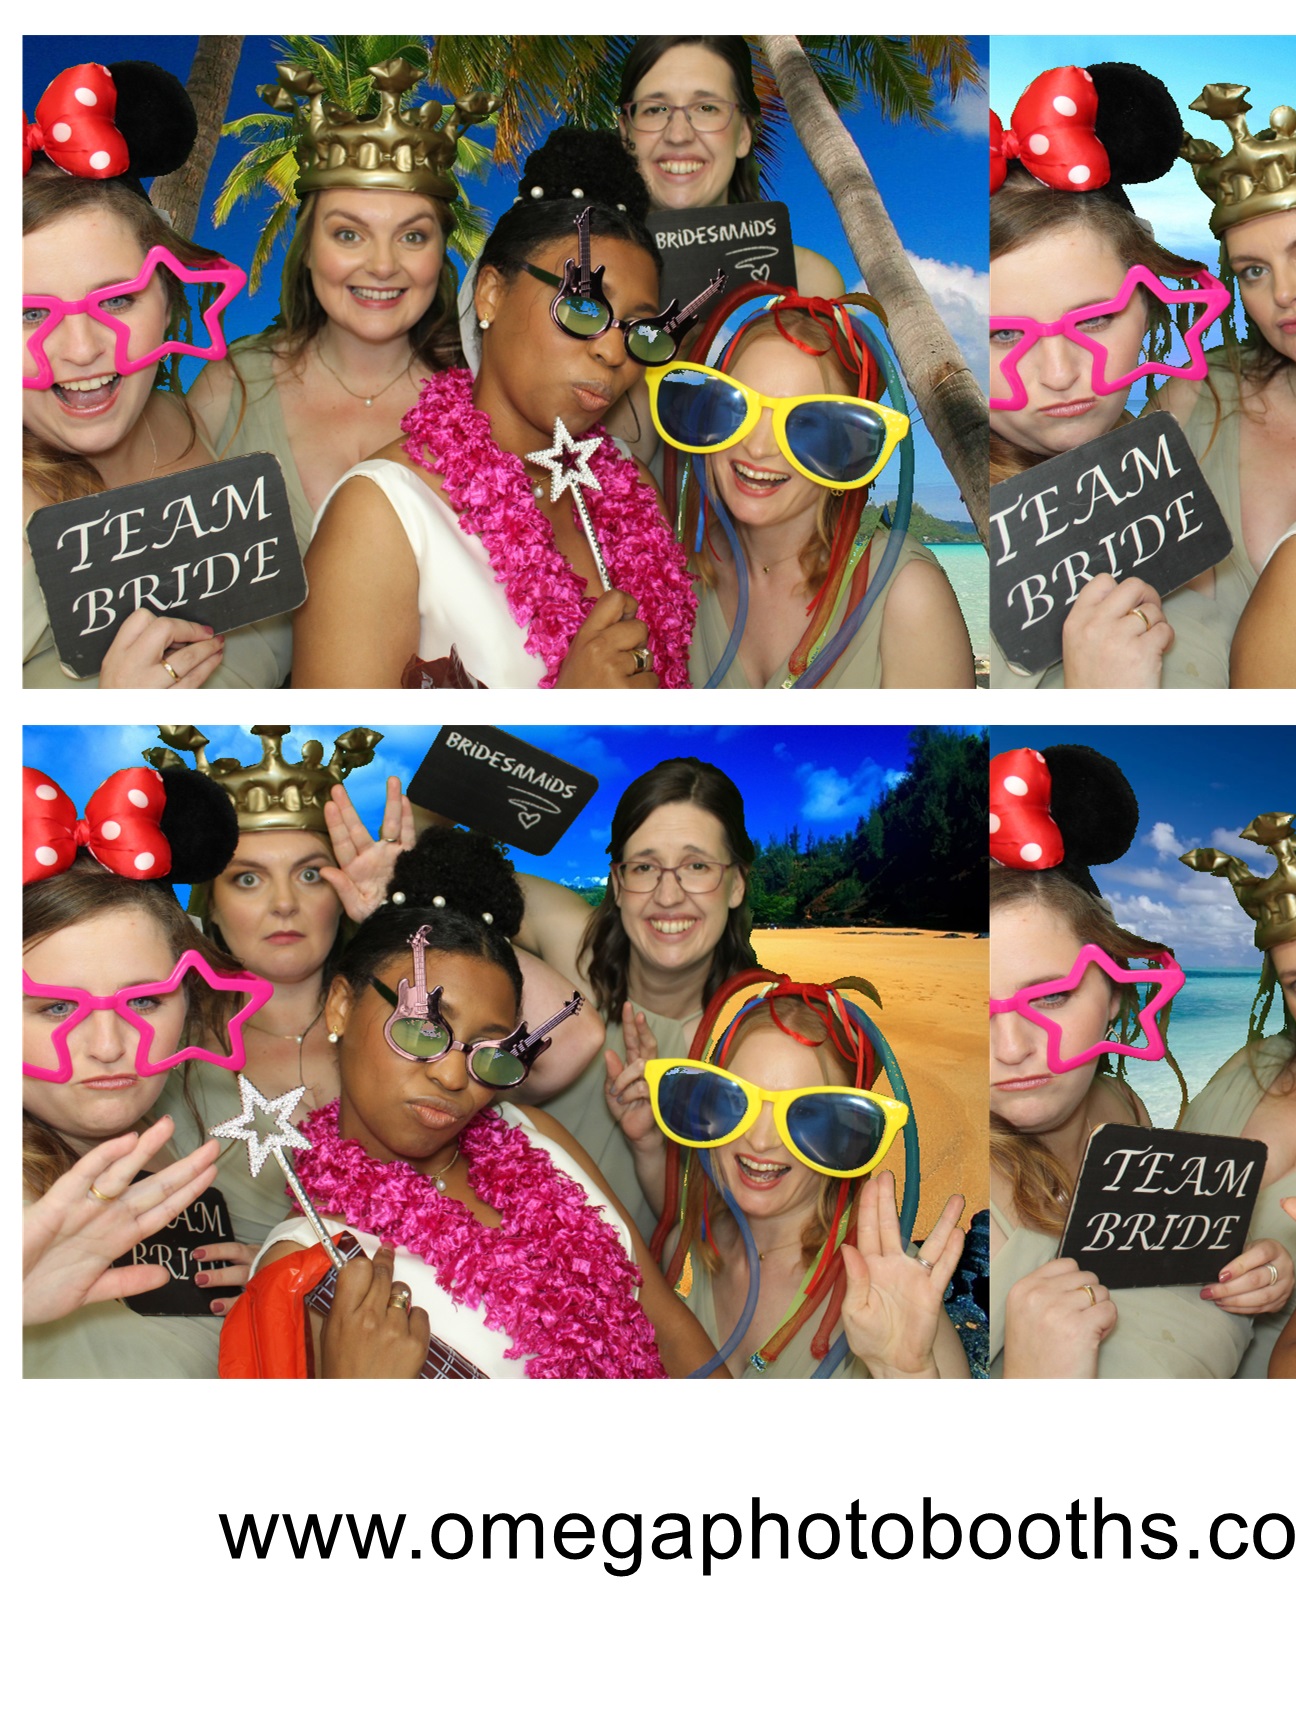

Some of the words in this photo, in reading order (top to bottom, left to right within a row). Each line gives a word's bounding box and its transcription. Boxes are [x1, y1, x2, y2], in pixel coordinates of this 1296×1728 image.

[57, 475, 272, 574] TEAM
[989, 433, 1182, 567] TEAM
[72, 537, 281, 637] BRIDE
[1007, 490, 1204, 631] BRIDE
[1102, 1145, 1256, 1198] TEAM
[1081, 1212, 1241, 1252] BRIDE
